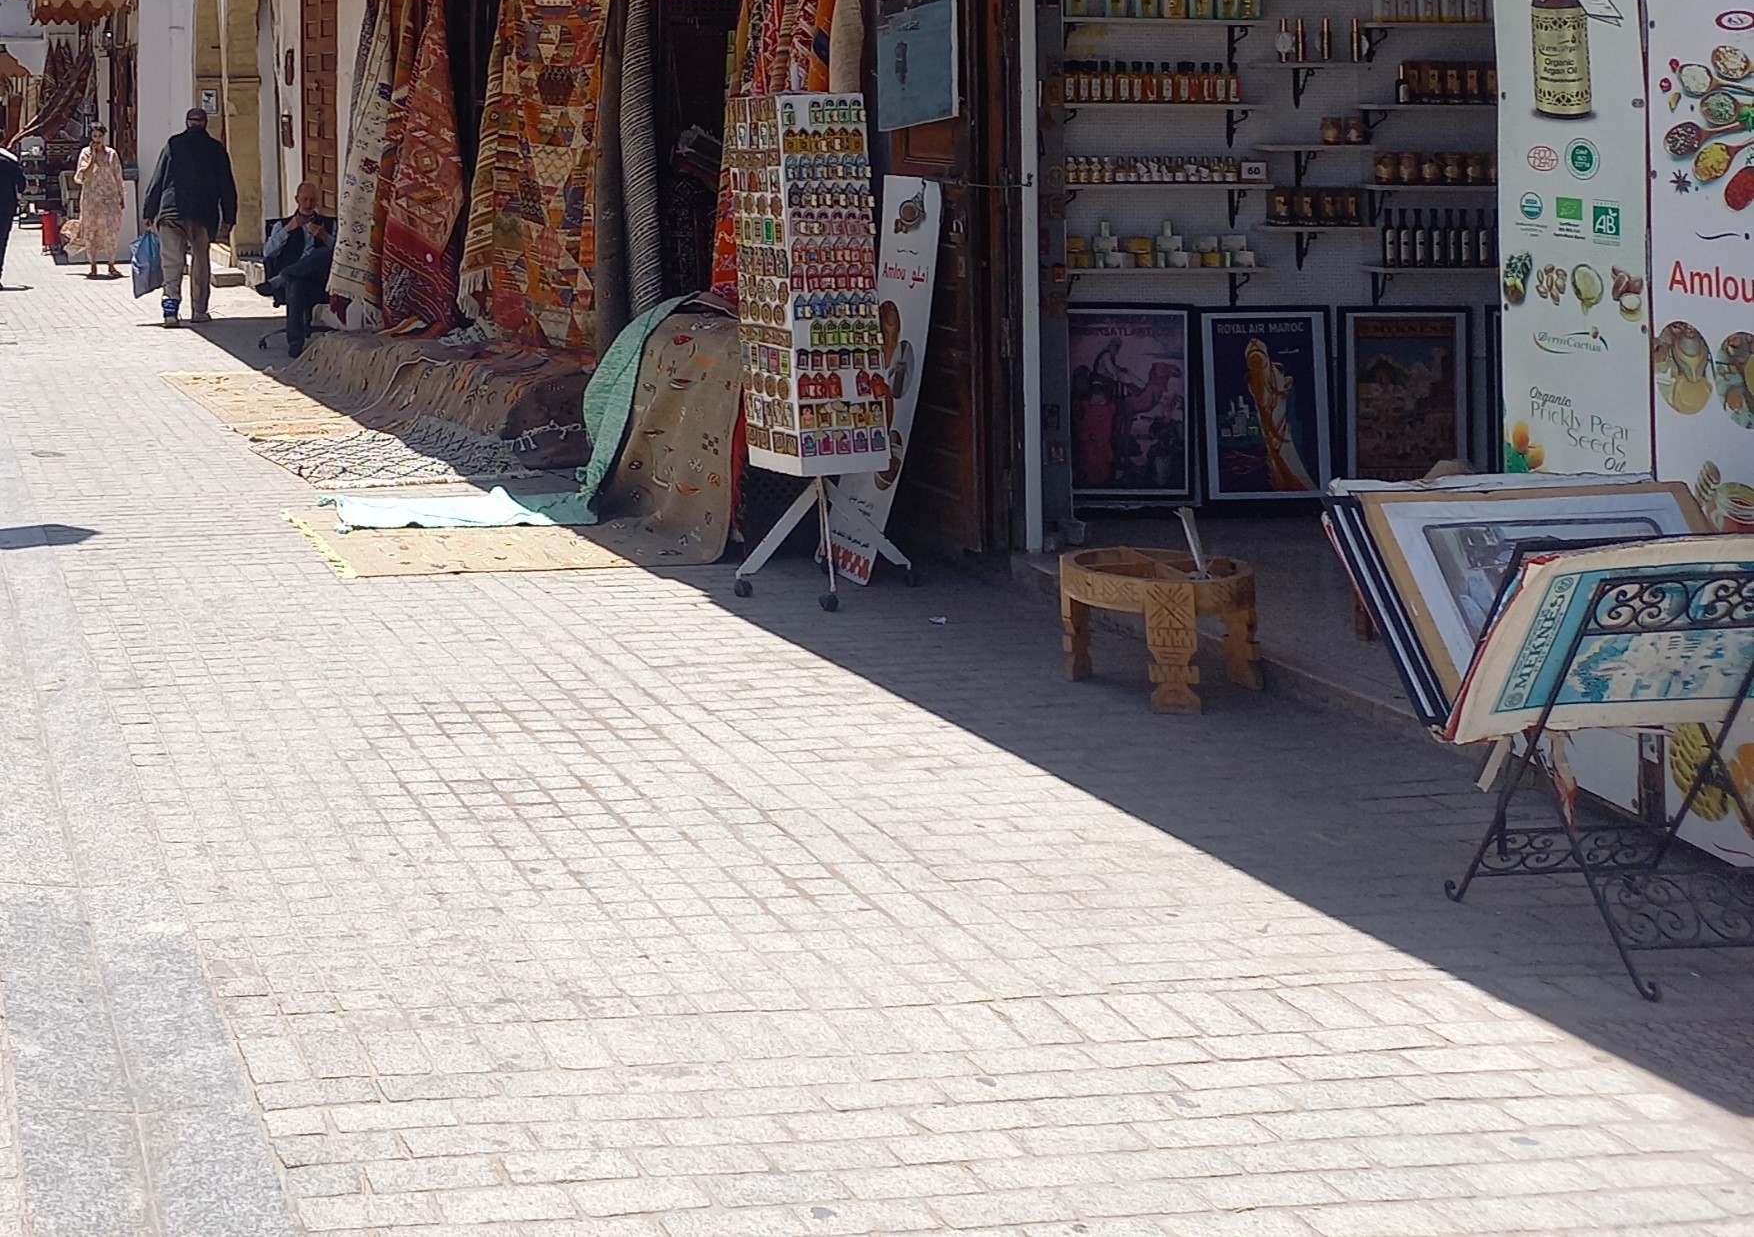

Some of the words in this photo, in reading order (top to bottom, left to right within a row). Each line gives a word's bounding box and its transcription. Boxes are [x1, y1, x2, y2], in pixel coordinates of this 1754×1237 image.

[1247, 166, 1261, 175] 60
[1594, 214, 1617, 235] AB
[1668, 260, 1754, 303] Amlou
[1216, 323, 1247, 335] ROYAL
[1248, 323, 1265, 334] AIR
[1268, 322, 1305, 333] MAROC
[1529, 386, 1572, 408] Organic
[1531, 400, 1584, 432] Prickly
[1590, 414, 1632, 442] Pear
[1567, 427, 1626, 457] Seeds
